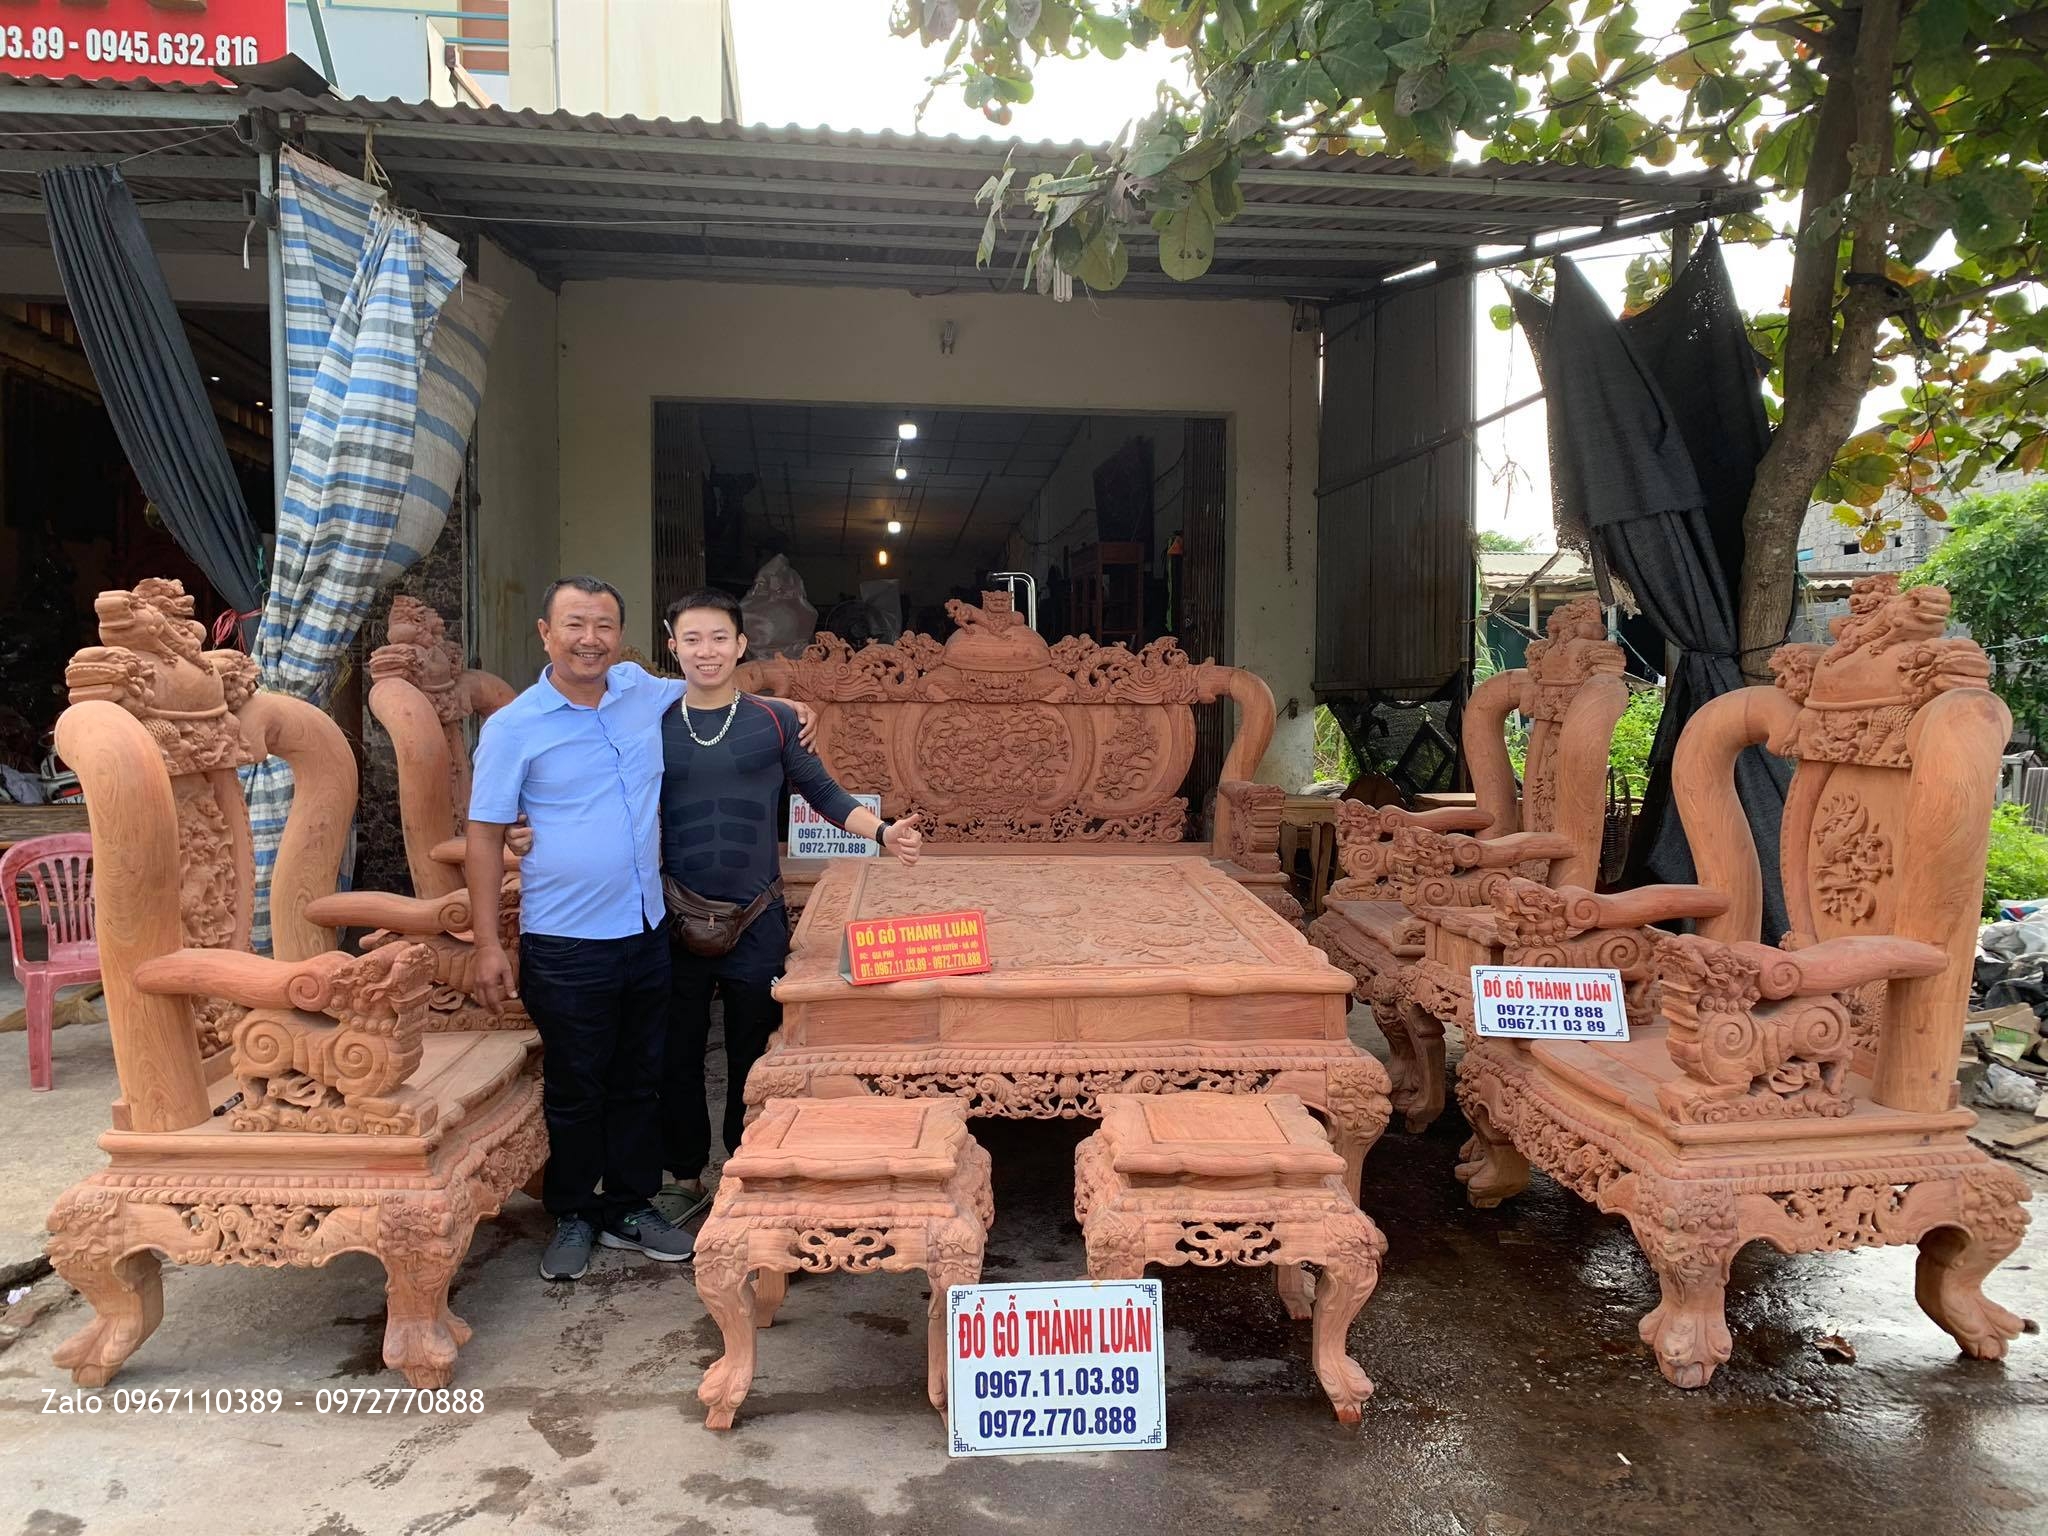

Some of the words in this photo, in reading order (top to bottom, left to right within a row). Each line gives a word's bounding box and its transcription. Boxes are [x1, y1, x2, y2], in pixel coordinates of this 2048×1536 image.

[86, 28, 258, 66] 0945.632.816
[799, 842, 866, 854] 0972.770.888
[878, 921, 897, 945] GỖ
[899, 922, 942, 943] THÀNH
[944, 918, 979, 938] LUÂN
[874, 957, 928, 977] 0967.11.03.89
[932, 951, 982, 969] 0972.770.888
[1483, 974, 1502, 998] ĐỒ
[1505, 974, 1524, 999] GỖ
[1527, 978, 1572, 1001] THÀNH
[1576, 980, 1612, 1002] LUÂN
[1496, 1004, 1570, 1017] 0972.770
[1574, 1006, 1604, 1018] 888
[1498, 1017, 1557, 1031] 0967.11
[1563, 1019, 1582, 1032] 03
[1587, 1020, 1606, 1032] 89
[958, 1297, 986, 1359] ĐỒ
[992, 1294, 1019, 1358] GỖ
[1025, 1299, 1093, 1356] THÀNH
[1099, 1298, 1152, 1354] LUÂN
[975, 1366, 1140, 1399] 0967.11.03.89
[979, 1406, 1137, 1439] 0972.770.888
